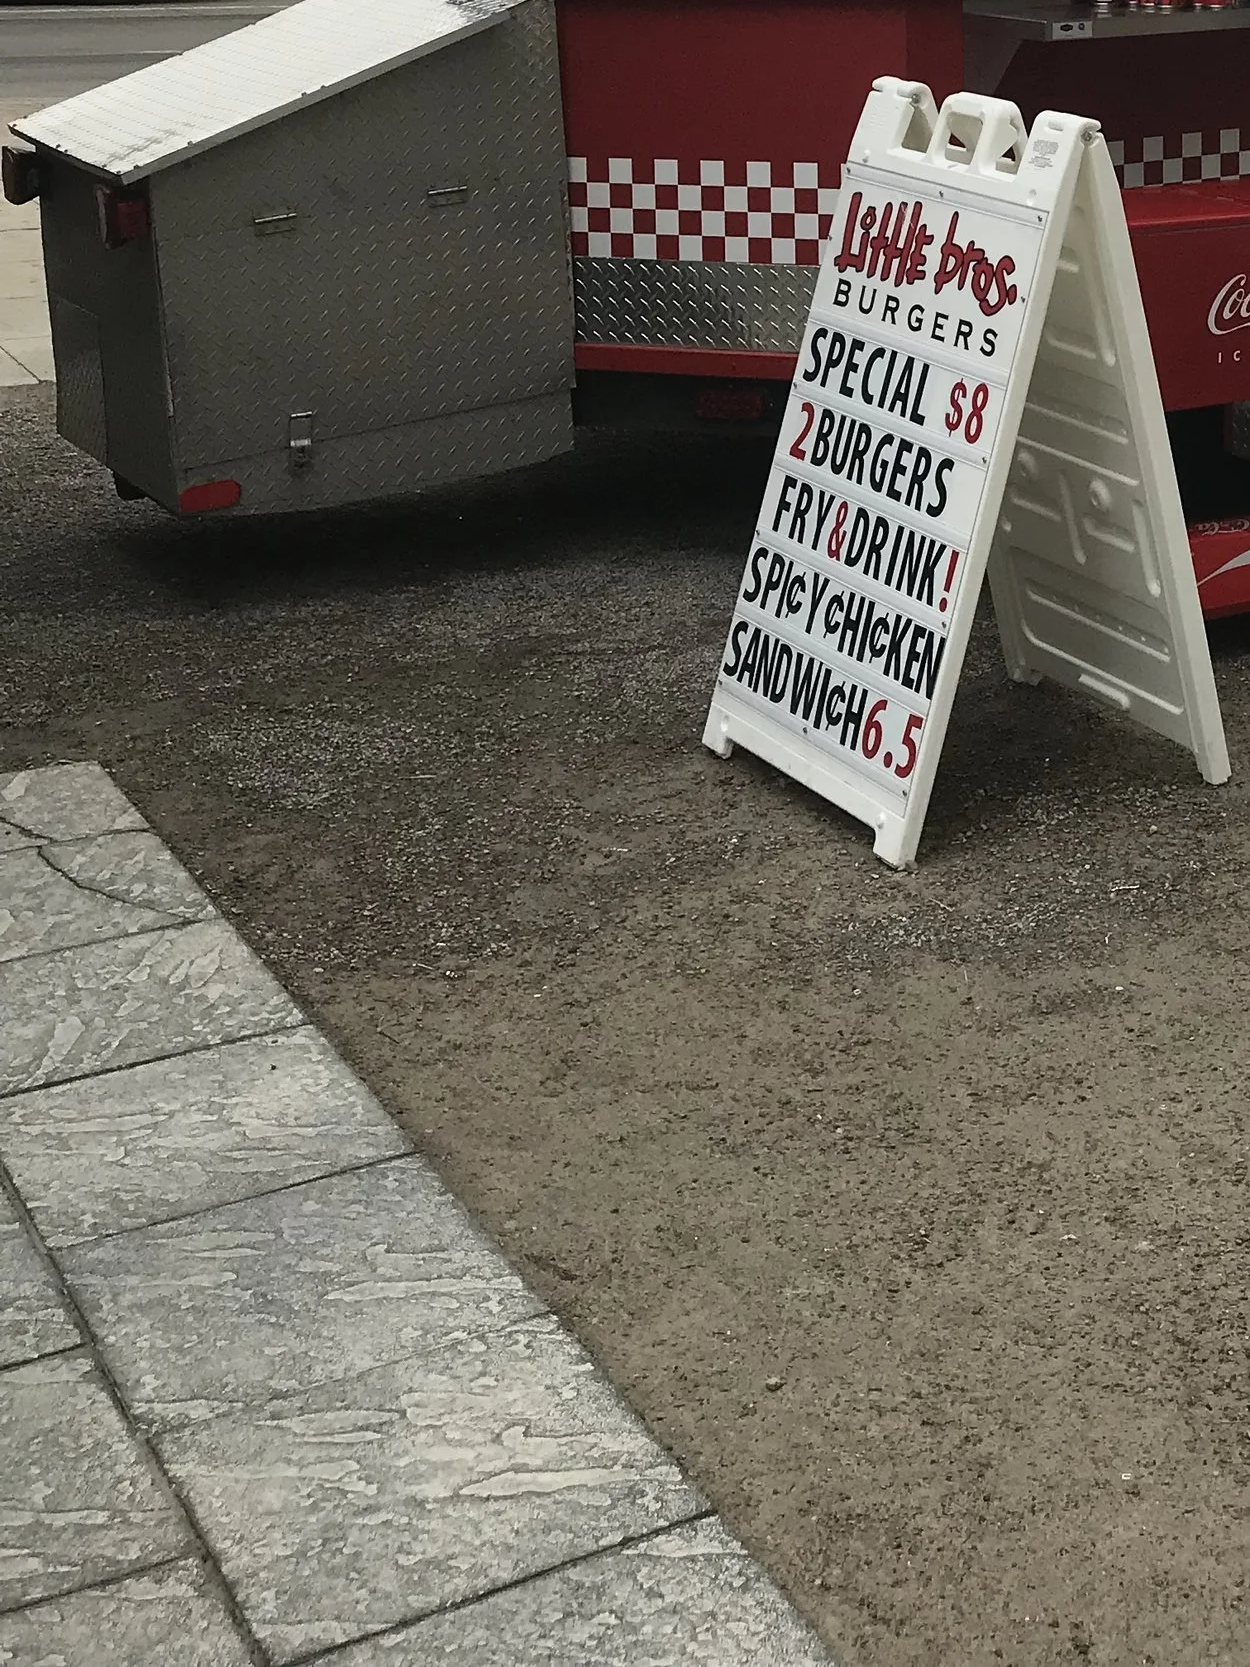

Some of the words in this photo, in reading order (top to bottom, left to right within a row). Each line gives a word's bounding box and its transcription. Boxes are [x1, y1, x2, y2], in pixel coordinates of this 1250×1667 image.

[833, 278, 999, 357] BURGERS
[802, 327, 930, 426] SPECIAL
[944, 376, 990, 445] $8
